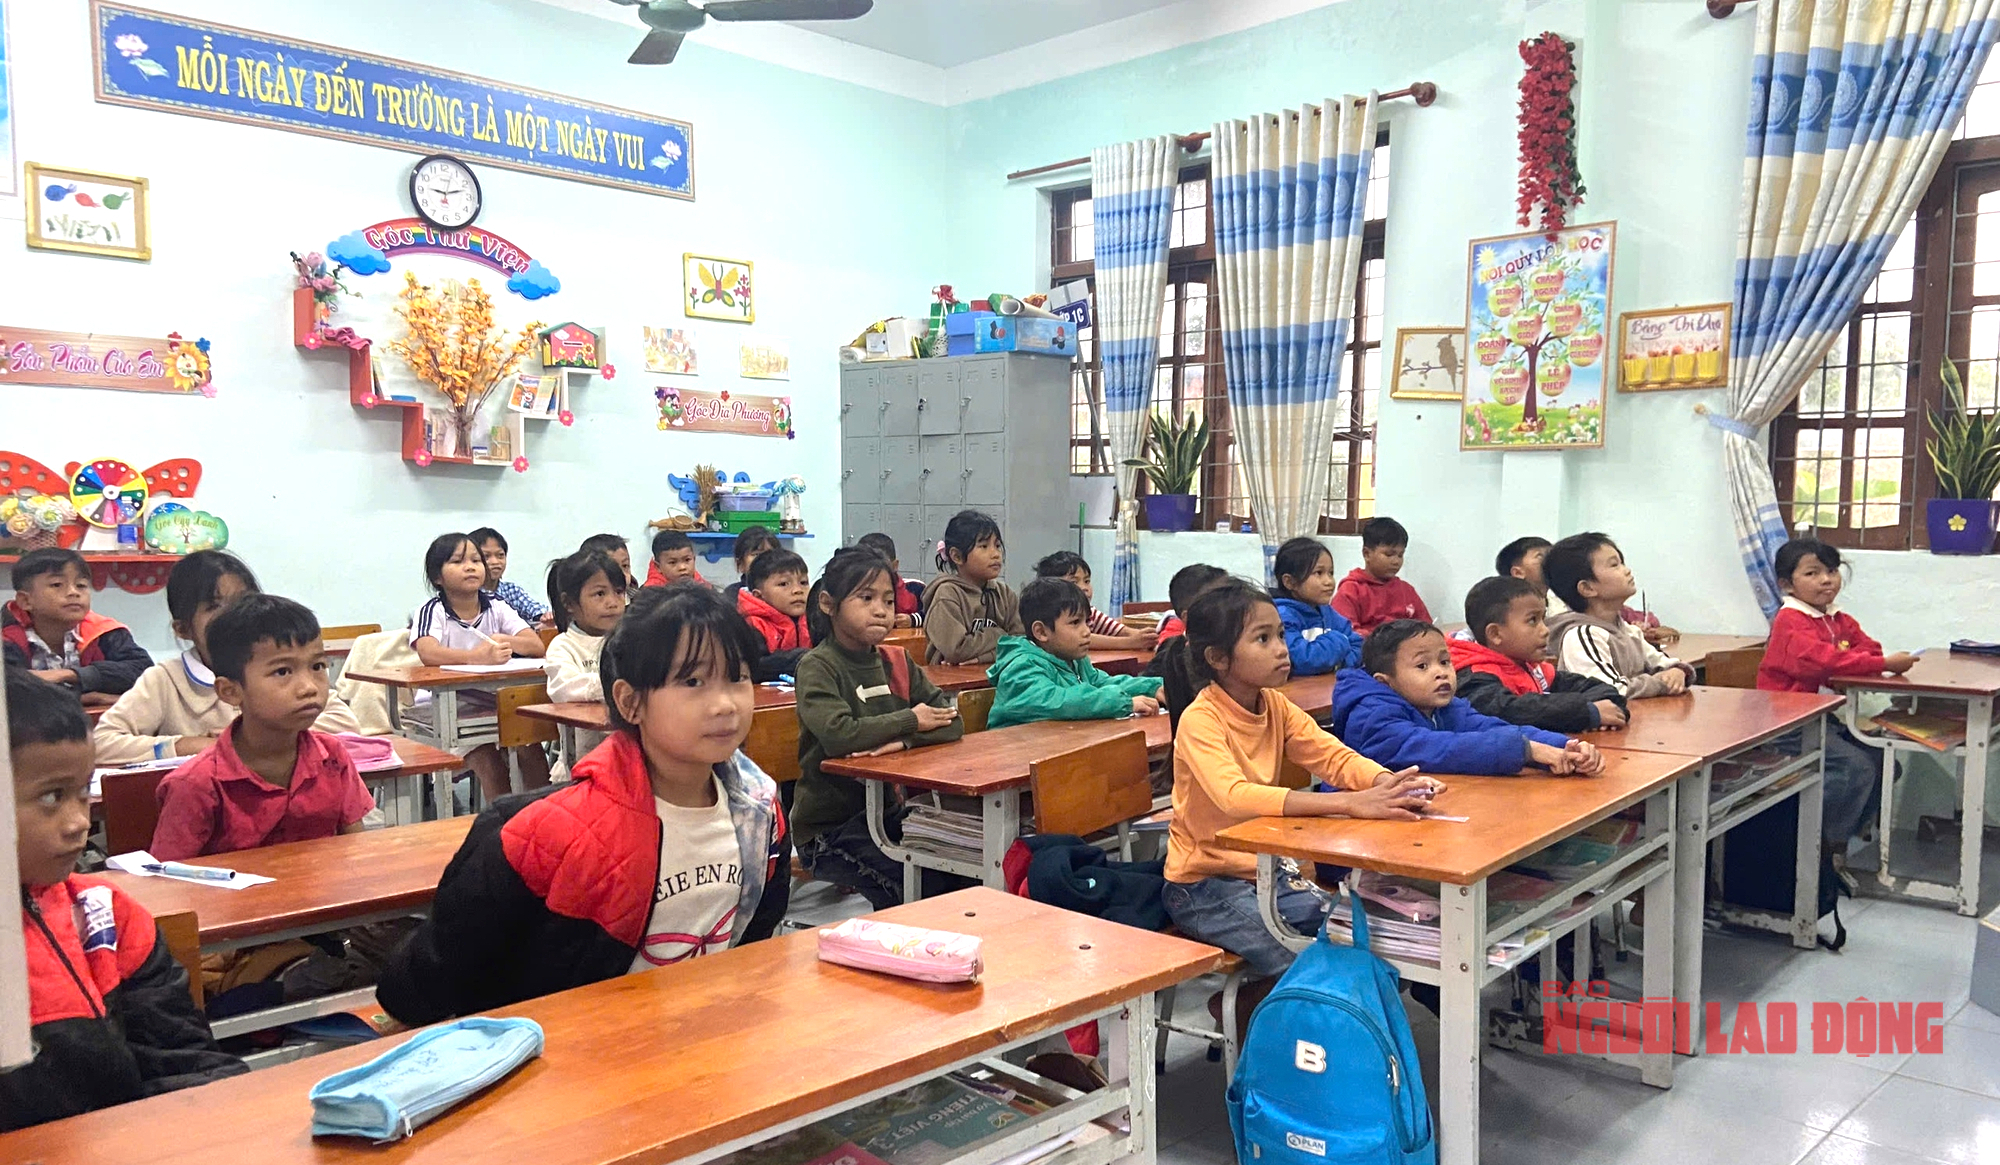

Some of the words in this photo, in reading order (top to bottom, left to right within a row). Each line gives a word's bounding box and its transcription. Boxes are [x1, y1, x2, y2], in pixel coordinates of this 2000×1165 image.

[176, 35, 230, 96] MỖI
[236, 51, 307, 108] NGÀY
[313, 60, 365, 119] ĐẾN
[372, 80, 465, 137] TRƯỜNG
[471, 94, 500, 143] LÀ
[505, 103, 550, 158] MỘT
[555, 115, 608, 164] NGÀY
[613, 132, 645, 171] VUI
[430, 166, 437, 174] 11
[440, 164, 449, 172] 12
[421, 173, 430, 182] 10
[462, 180, 468, 188] 2
[417, 185, 424, 194] 9
[421, 199, 428, 207] 8
[466, 193, 472, 201] 3
[442, 214, 449, 222] 6
[455, 212, 461, 221] 5
[364, 226, 415, 251] Góc
[481, 233, 530, 275] Viện
[1505, 253, 1532, 274] QUY
[1071, 307, 1084, 323] 1C
[1669, 315, 1694, 331] Thi
[137, 350, 165, 378] Em
[685, 397, 708, 422] Góc
[695, 864, 722, 886] EN
[1295, 1039, 1326, 1074] B
[1302, 1137, 1324, 1150] PLAN
